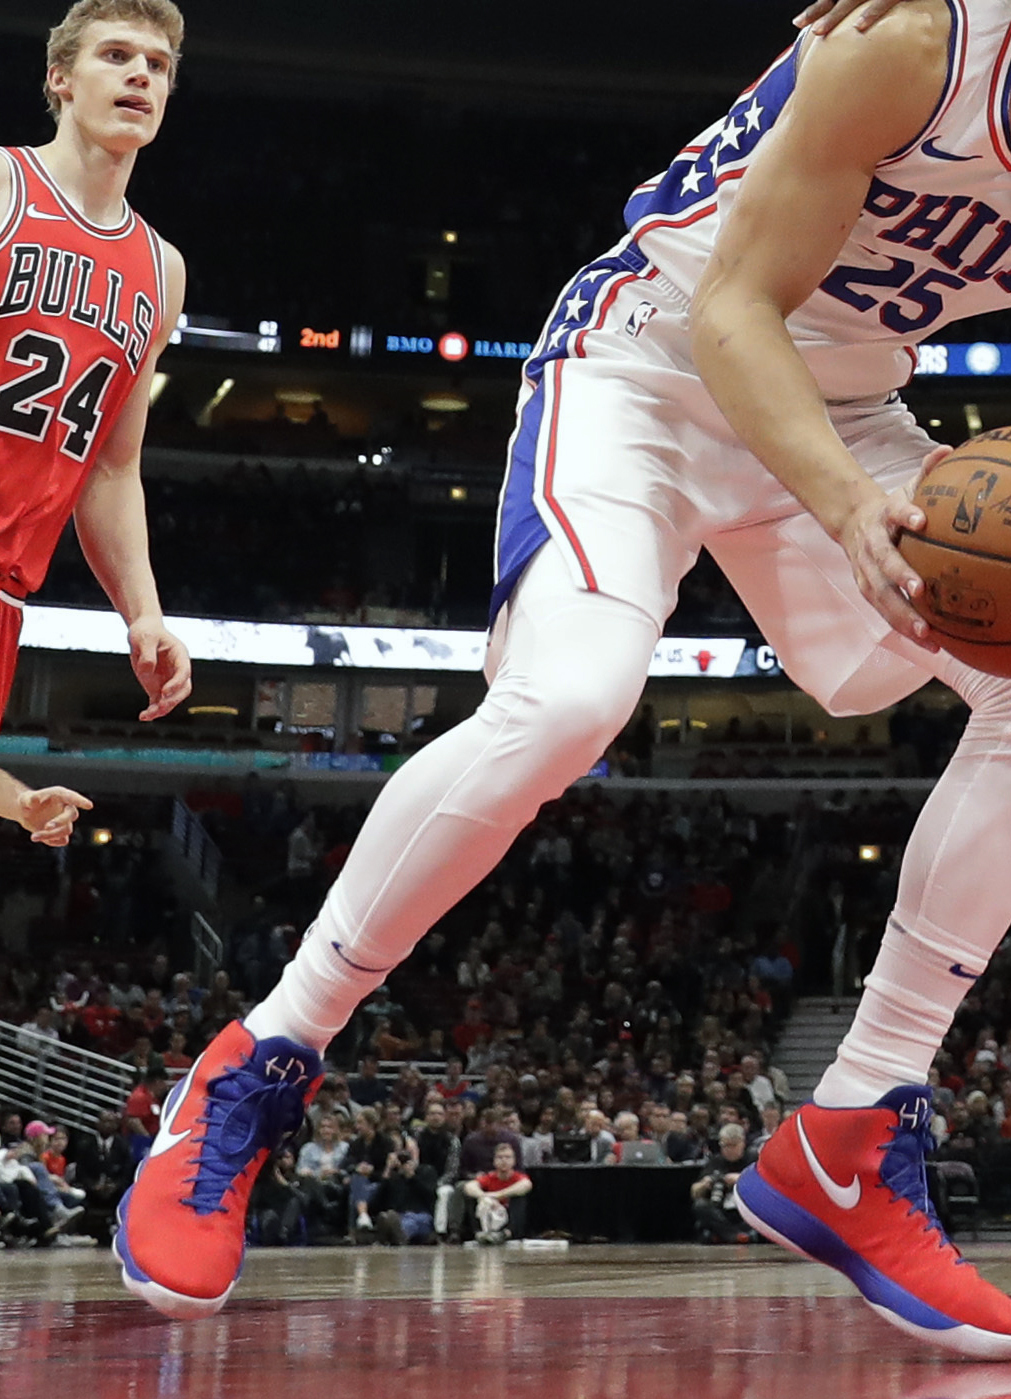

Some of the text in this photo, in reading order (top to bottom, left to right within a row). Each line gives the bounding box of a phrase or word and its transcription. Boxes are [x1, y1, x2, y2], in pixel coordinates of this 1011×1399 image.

[0, 243, 154, 375] BULLS
[819, 250, 967, 335] 25
[300, 327, 340, 349] 2nd
[386, 335, 434, 353] BMO
[0, 329, 119, 463] 24
